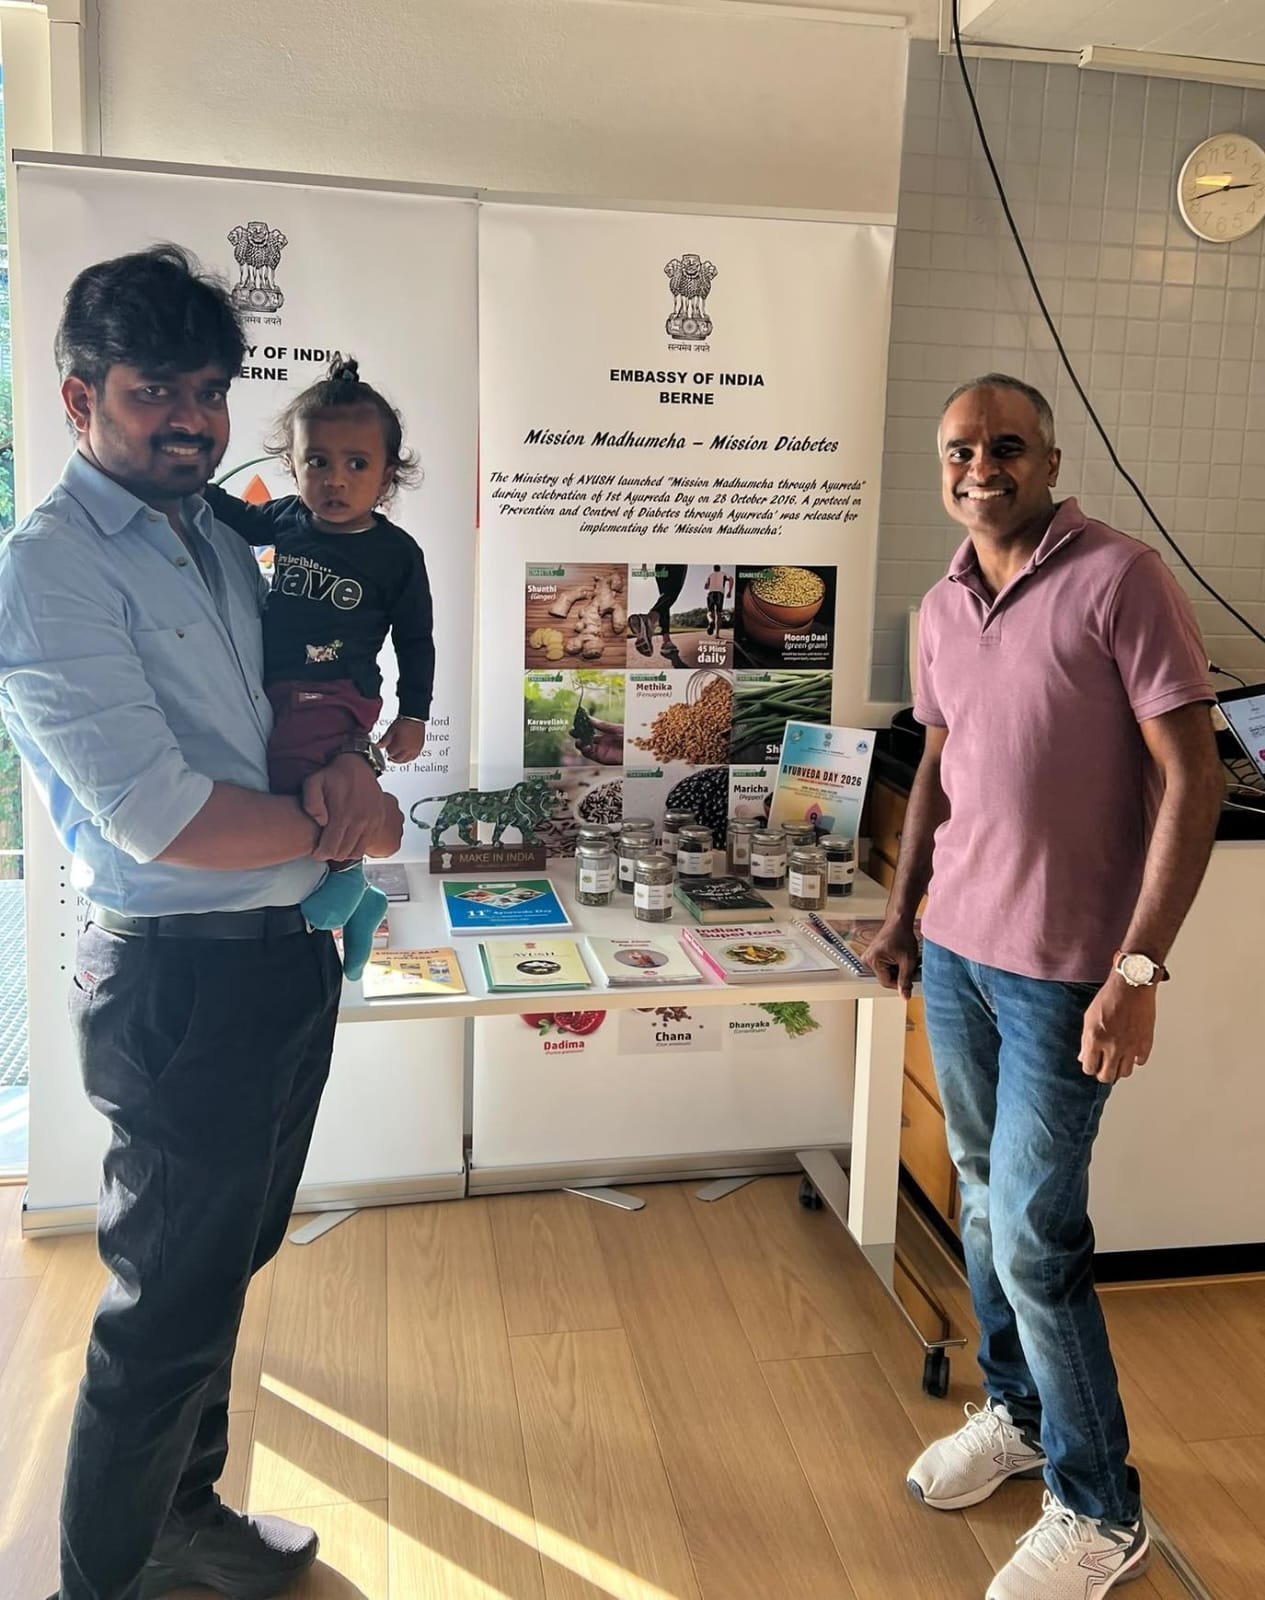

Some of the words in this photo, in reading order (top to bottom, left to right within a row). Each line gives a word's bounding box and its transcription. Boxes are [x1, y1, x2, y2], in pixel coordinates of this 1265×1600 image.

[264, 346, 288, 359] OF
[240, 366, 288, 381] ERNE
[610, 369, 688, 384] EMBASSY
[693, 372, 715, 385] OF
[720, 373, 765, 386] INDIA
[659, 391, 714, 405] BERNE
[523, 428, 585, 446] Mission
[590, 430, 687, 449] Madhumeha
[709, 435, 769, 451] Mission
[774, 436, 839, 453] Diabetes
[490, 472, 509, 483] The
[512, 473, 558, 487] Ministry
[562, 473, 575, 486] of
[576, 475, 616, 486] AYUSH
[617, 475, 664, 486] launched
[713, 477, 773, 489] Madhumeha
[777, 479, 817, 492] through
[491, 488, 528, 502] during
[531, 489, 587, 501] celebration
[591, 490, 604, 503] of
[605, 491, 621, 501] 1st
[624, 492, 671, 504] Ayurveda
[674, 493, 694, 505] Day
[713, 494, 727, 503] 28
[731, 494, 768, 504] October
[770, 494, 797, 505] 2016.
[801, 495, 810, 505] A
[812, 495, 849, 507] protocol
[852, 498, 861, 506] on
[559, 505, 581, 516] and
[582, 506, 620, 517] Control
[623, 506, 635, 519] of
[637, 507, 681, 518] Diabetes
[684, 508, 723, 521] through
[780, 512, 800, 520] was
[803, 510, 842, 521] released
[844, 510, 858, 523] for
[579, 522, 649, 535] implementing
[652, 522, 669, 534] the
[784, 633, 810, 644] Moong
[811, 633, 828, 641] Daal
[697, 645, 708, 653] 45
[709, 645, 726, 653] Mins
[697, 652, 726, 665] daily
[636, 682, 673, 691] Methika
[431, 716, 450, 726] lord
[426, 732, 449, 741] three
[439, 747, 450, 756] of
[400, 763, 412, 772] of
[414, 762, 449, 774] healing
[782, 764, 820, 779] AYURVEDA
[822, 771, 839, 783] DAY
[733, 784, 769, 793] Maricha
[459, 853, 489, 863] MAKE
[493, 852, 503, 862] IN
[506, 851, 535, 861] INDIA
[700, 929, 782, 938] Superfood
[729, 1020, 770, 1029] Dhanyaka
[655, 1031, 692, 1042] Chana
[543, 1040, 585, 1051] Dadima
